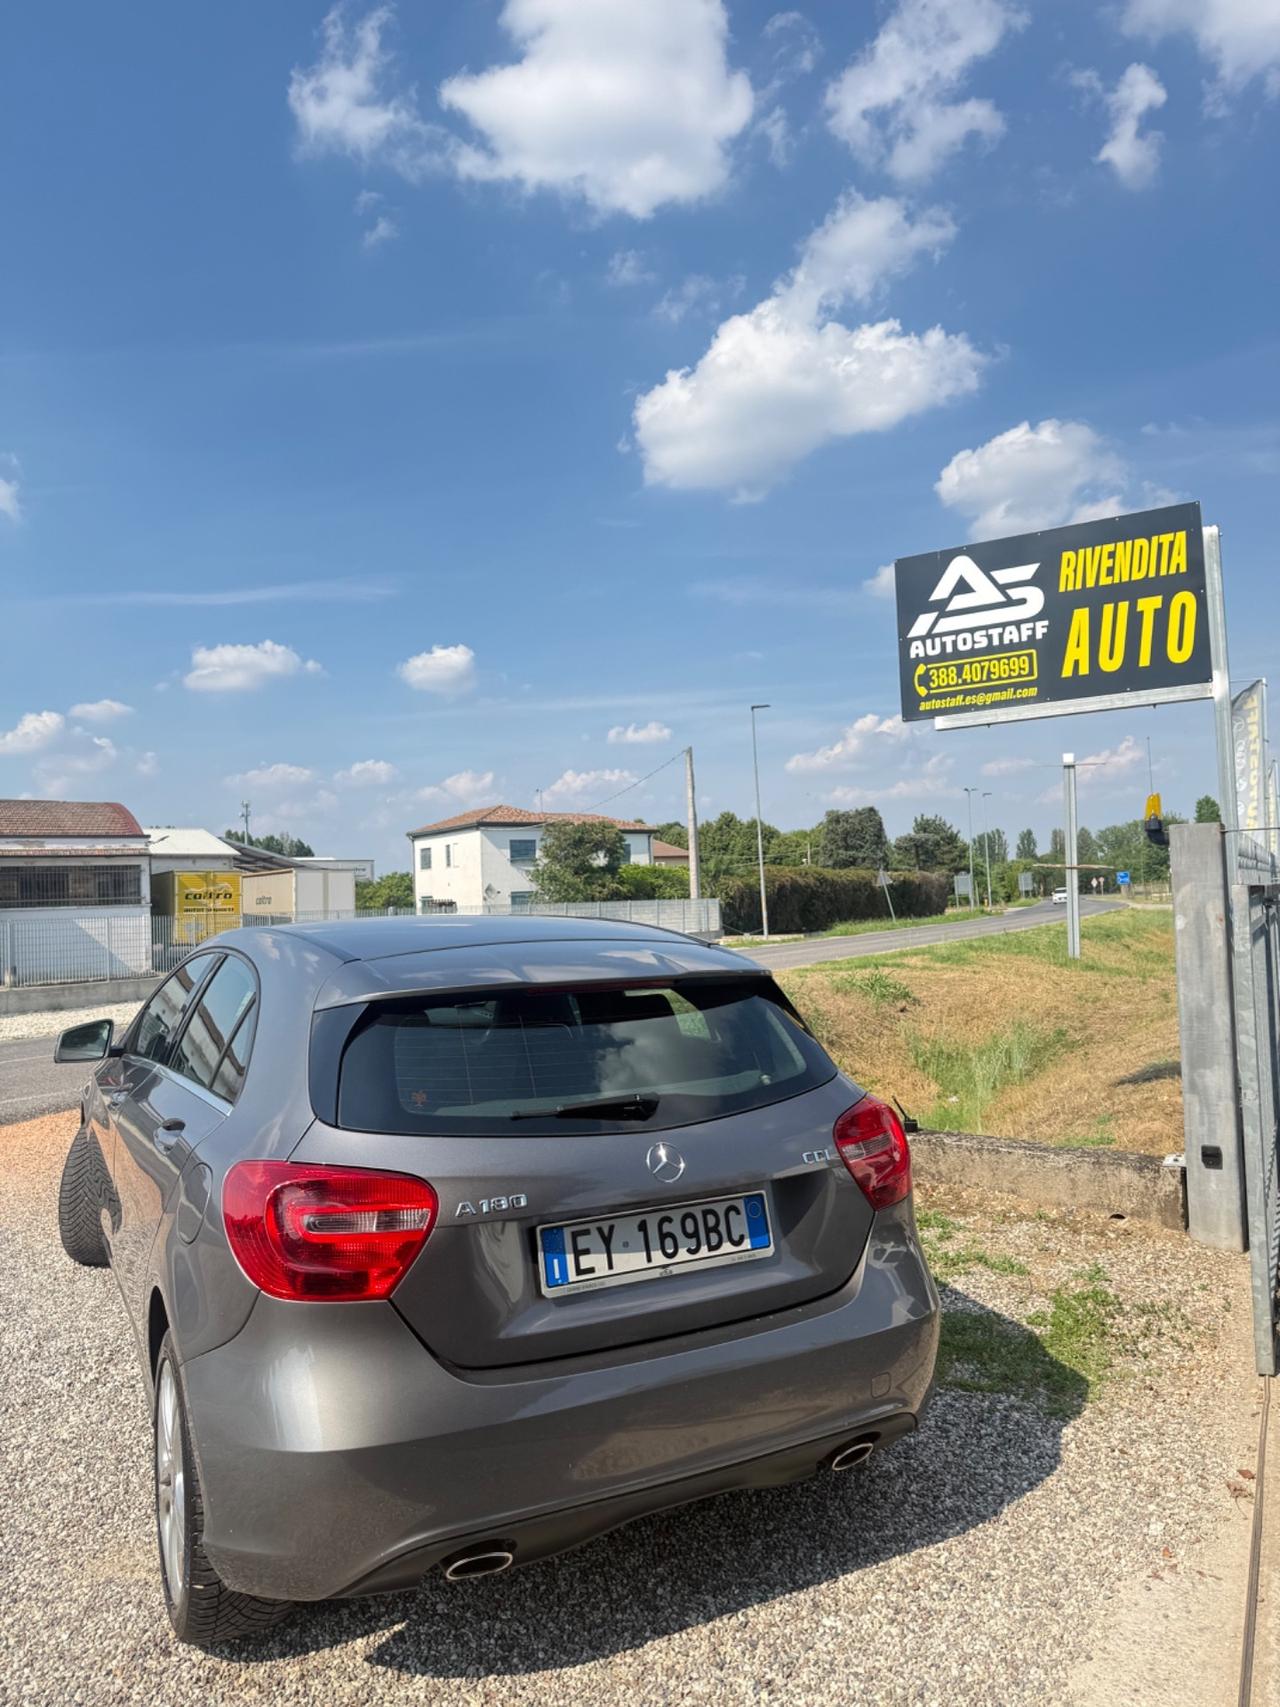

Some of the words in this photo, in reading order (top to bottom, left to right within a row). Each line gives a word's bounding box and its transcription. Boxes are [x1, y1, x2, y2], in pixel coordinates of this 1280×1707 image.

[1058, 530, 1187, 593] RIVENDITA
[910, 620, 1049, 659] AUTOSTAFF
[1061, 591, 1197, 678] AUTO
[929, 655, 1029, 688] 388.4079699
[919, 687, 1038, 711] autostaff.es@gmail.com
[571, 1223, 615, 1276] EY
[637, 1205, 745, 1264] 169BC
